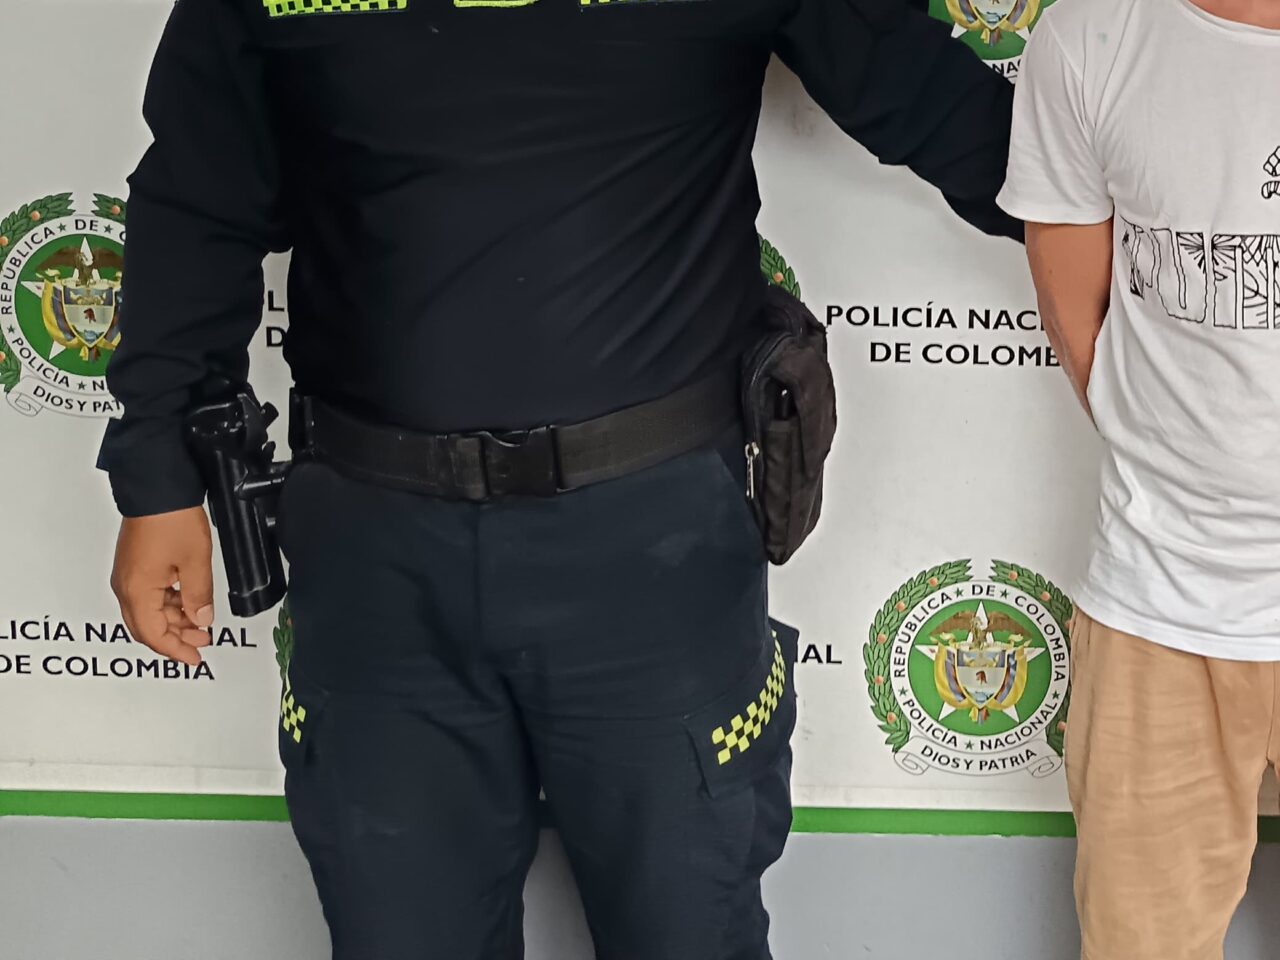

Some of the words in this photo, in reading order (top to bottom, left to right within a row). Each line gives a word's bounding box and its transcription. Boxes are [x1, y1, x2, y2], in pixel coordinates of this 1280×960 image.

[75, 219, 99, 231] DE
[826, 301, 958, 330] POLICÍA
[11, 337, 70, 388] POLICÍA
[870, 341, 911, 363] DE
[33, 385, 74, 410] DIOS
[77, 400, 87, 411] Y
[972, 585, 996, 596] DE
[1014, 596, 1066, 682] COLOMBIA
[42, 655, 215, 681] COLOMBIA
[903, 699, 958, 747] POLICÍA
[980, 704, 1058, 751] NACIONAL
[921, 745, 961, 768] DIOS
[963, 759, 973, 770] Y
[979, 749, 1037, 771] PATRIA
